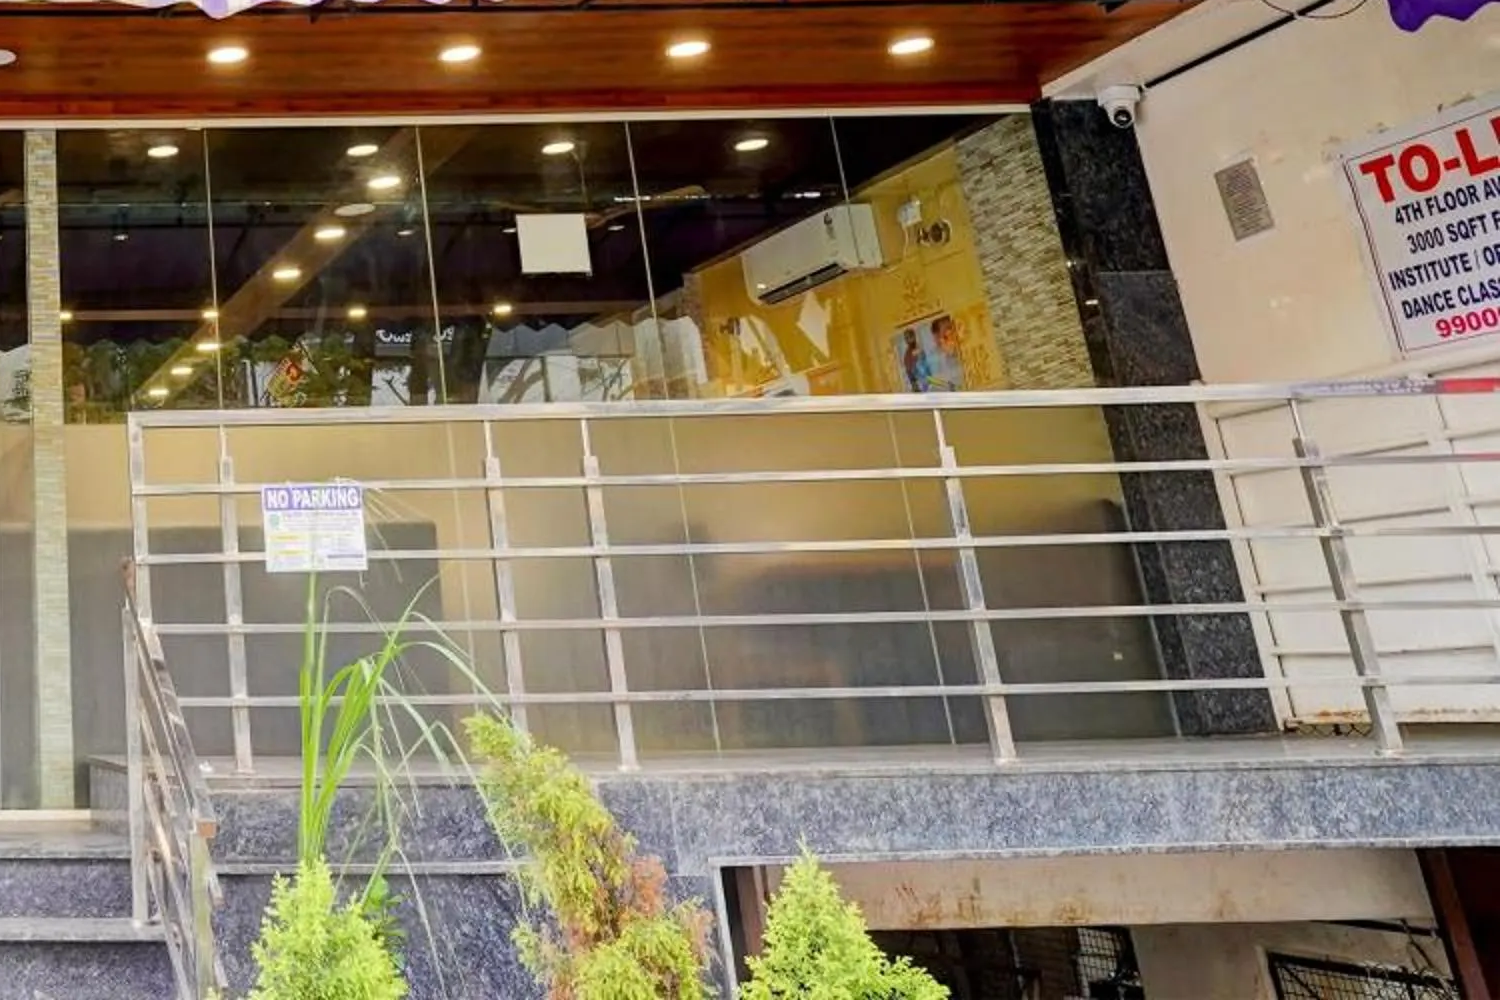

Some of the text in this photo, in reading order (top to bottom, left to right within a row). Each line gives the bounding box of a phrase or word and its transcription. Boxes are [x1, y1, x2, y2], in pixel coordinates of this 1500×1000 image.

[1394, 201, 1424, 225] 4TH
[1425, 183, 1480, 216] FLOOR
[1407, 227, 1445, 254] 3000
[1445, 213, 1488, 243] SQFT
[1388, 251, 1473, 290] INSTITUTE
[1401, 277, 1500, 319] DANCE CLAS
[1435, 306, 1500, 338] 9900
[266, 486, 359, 509] NO PARKING
